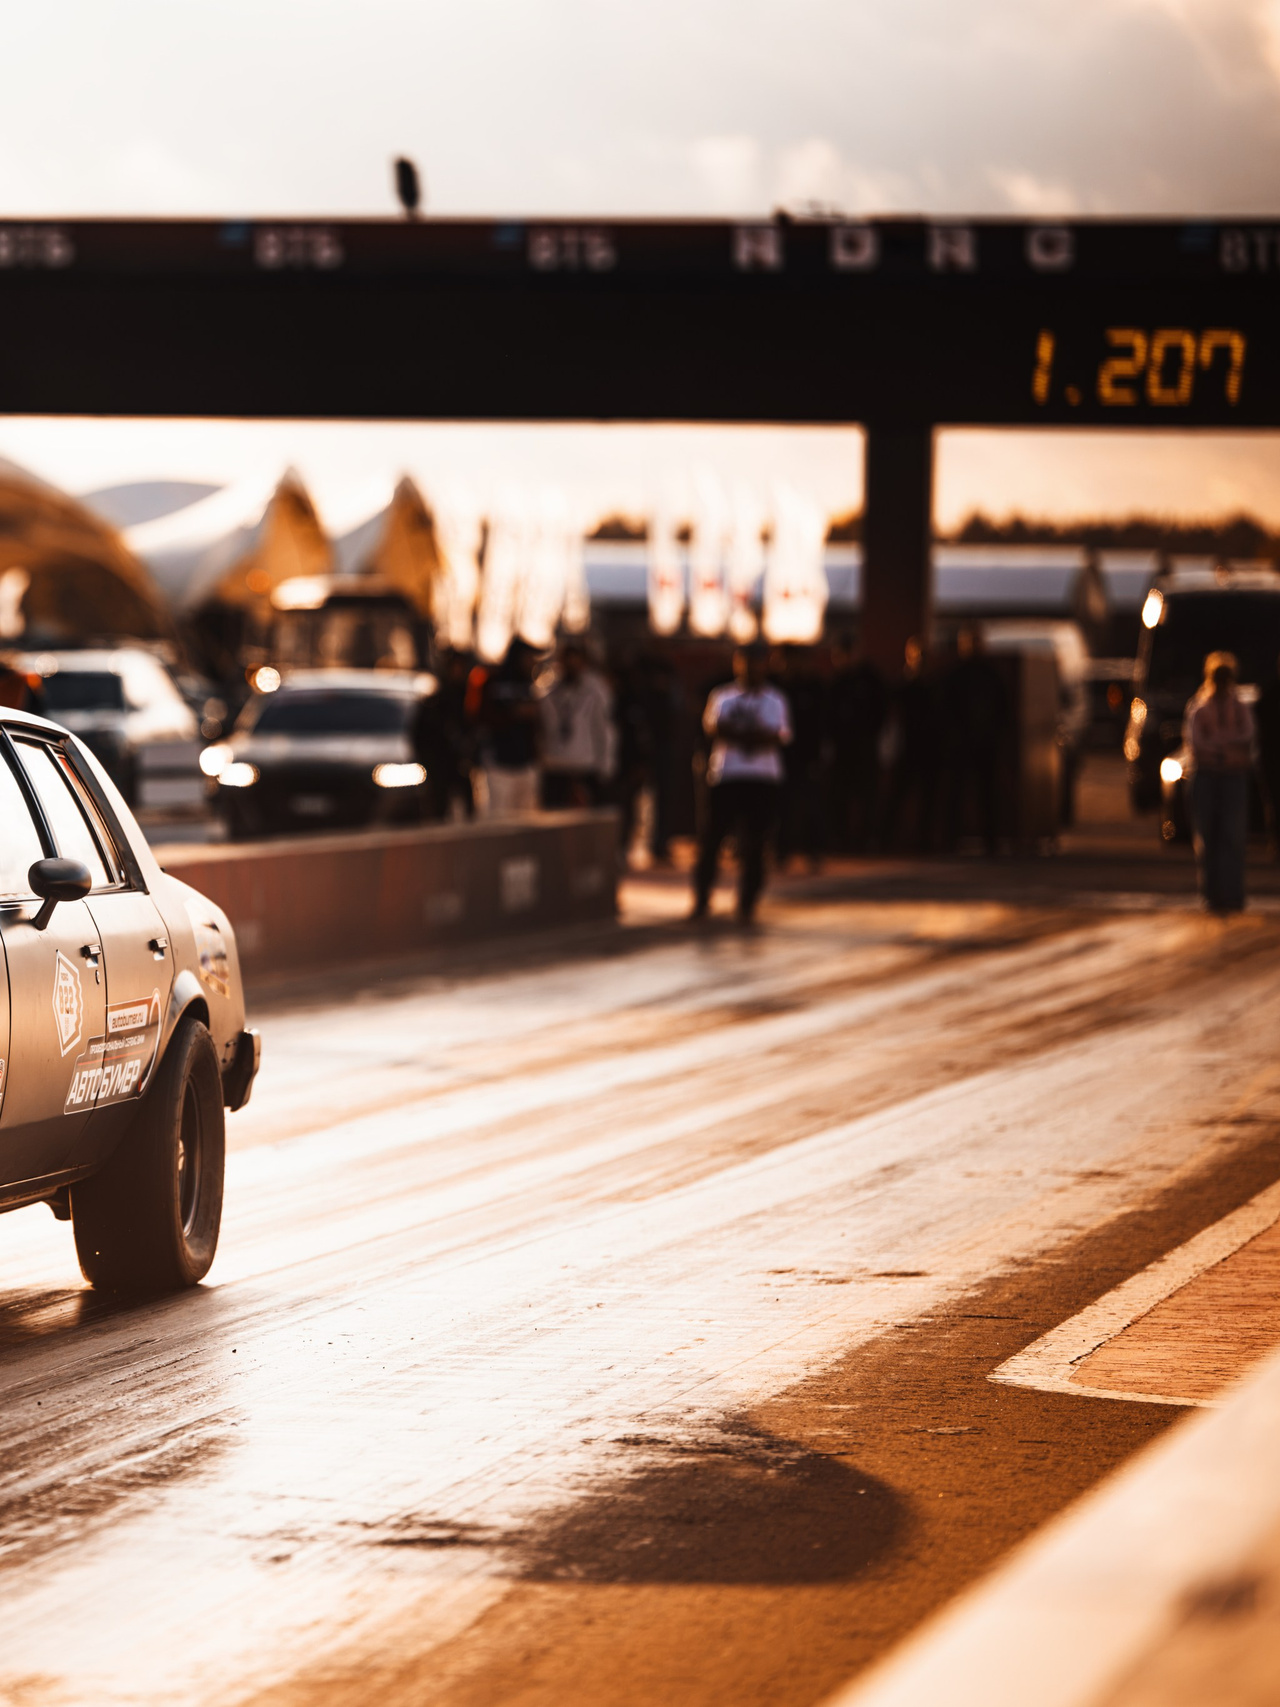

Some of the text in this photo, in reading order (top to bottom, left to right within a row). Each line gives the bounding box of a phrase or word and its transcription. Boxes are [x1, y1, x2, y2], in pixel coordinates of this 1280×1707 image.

[1032, 327, 1246, 406] 1.207
[58, 985, 74, 1014] 822
[112, 1012, 144, 1029] autobumer.ru
[66, 1059, 141, 1106] АВТОБУМЕР
